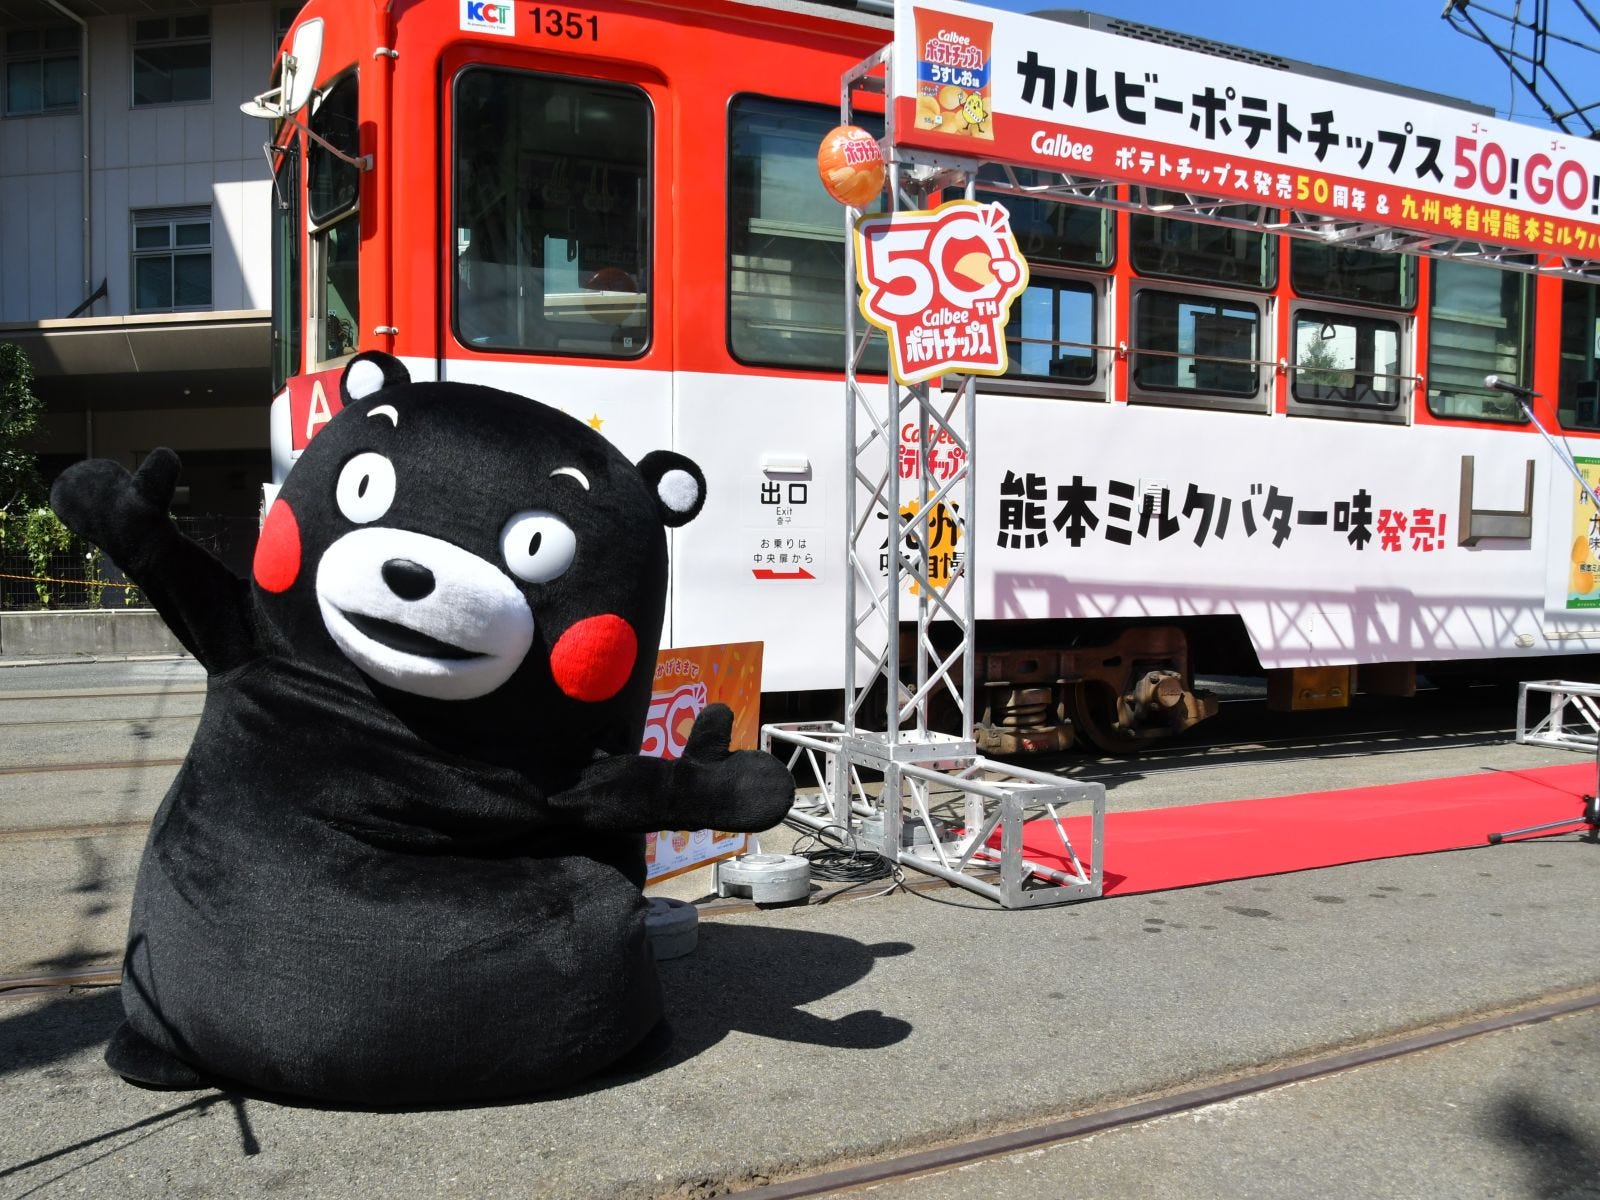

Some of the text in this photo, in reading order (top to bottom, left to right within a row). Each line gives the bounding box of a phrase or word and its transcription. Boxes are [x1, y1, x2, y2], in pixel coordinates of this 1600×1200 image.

[467, 1, 510, 24] KCT
[529, 7, 598, 42] 1351
[938, 29, 971, 46] Calbee
[925, 38, 984, 71] ポテトチップス
[931, 65, 980, 88] うすしお味
[1031, 130, 1094, 162] Calbee
[1376, 195, 1390, 214] &
[922, 308, 969, 326] Calbee
[976, 301, 997, 316] TH
[906, 321, 992, 362] ポテトチップス
[306, 380, 333, 440] A
[761, 481, 807, 504] 出口
[776, 506, 793, 516] Exit
[760, 538, 808, 550] お乗りは
[753, 553, 814, 564] 中央扉から
